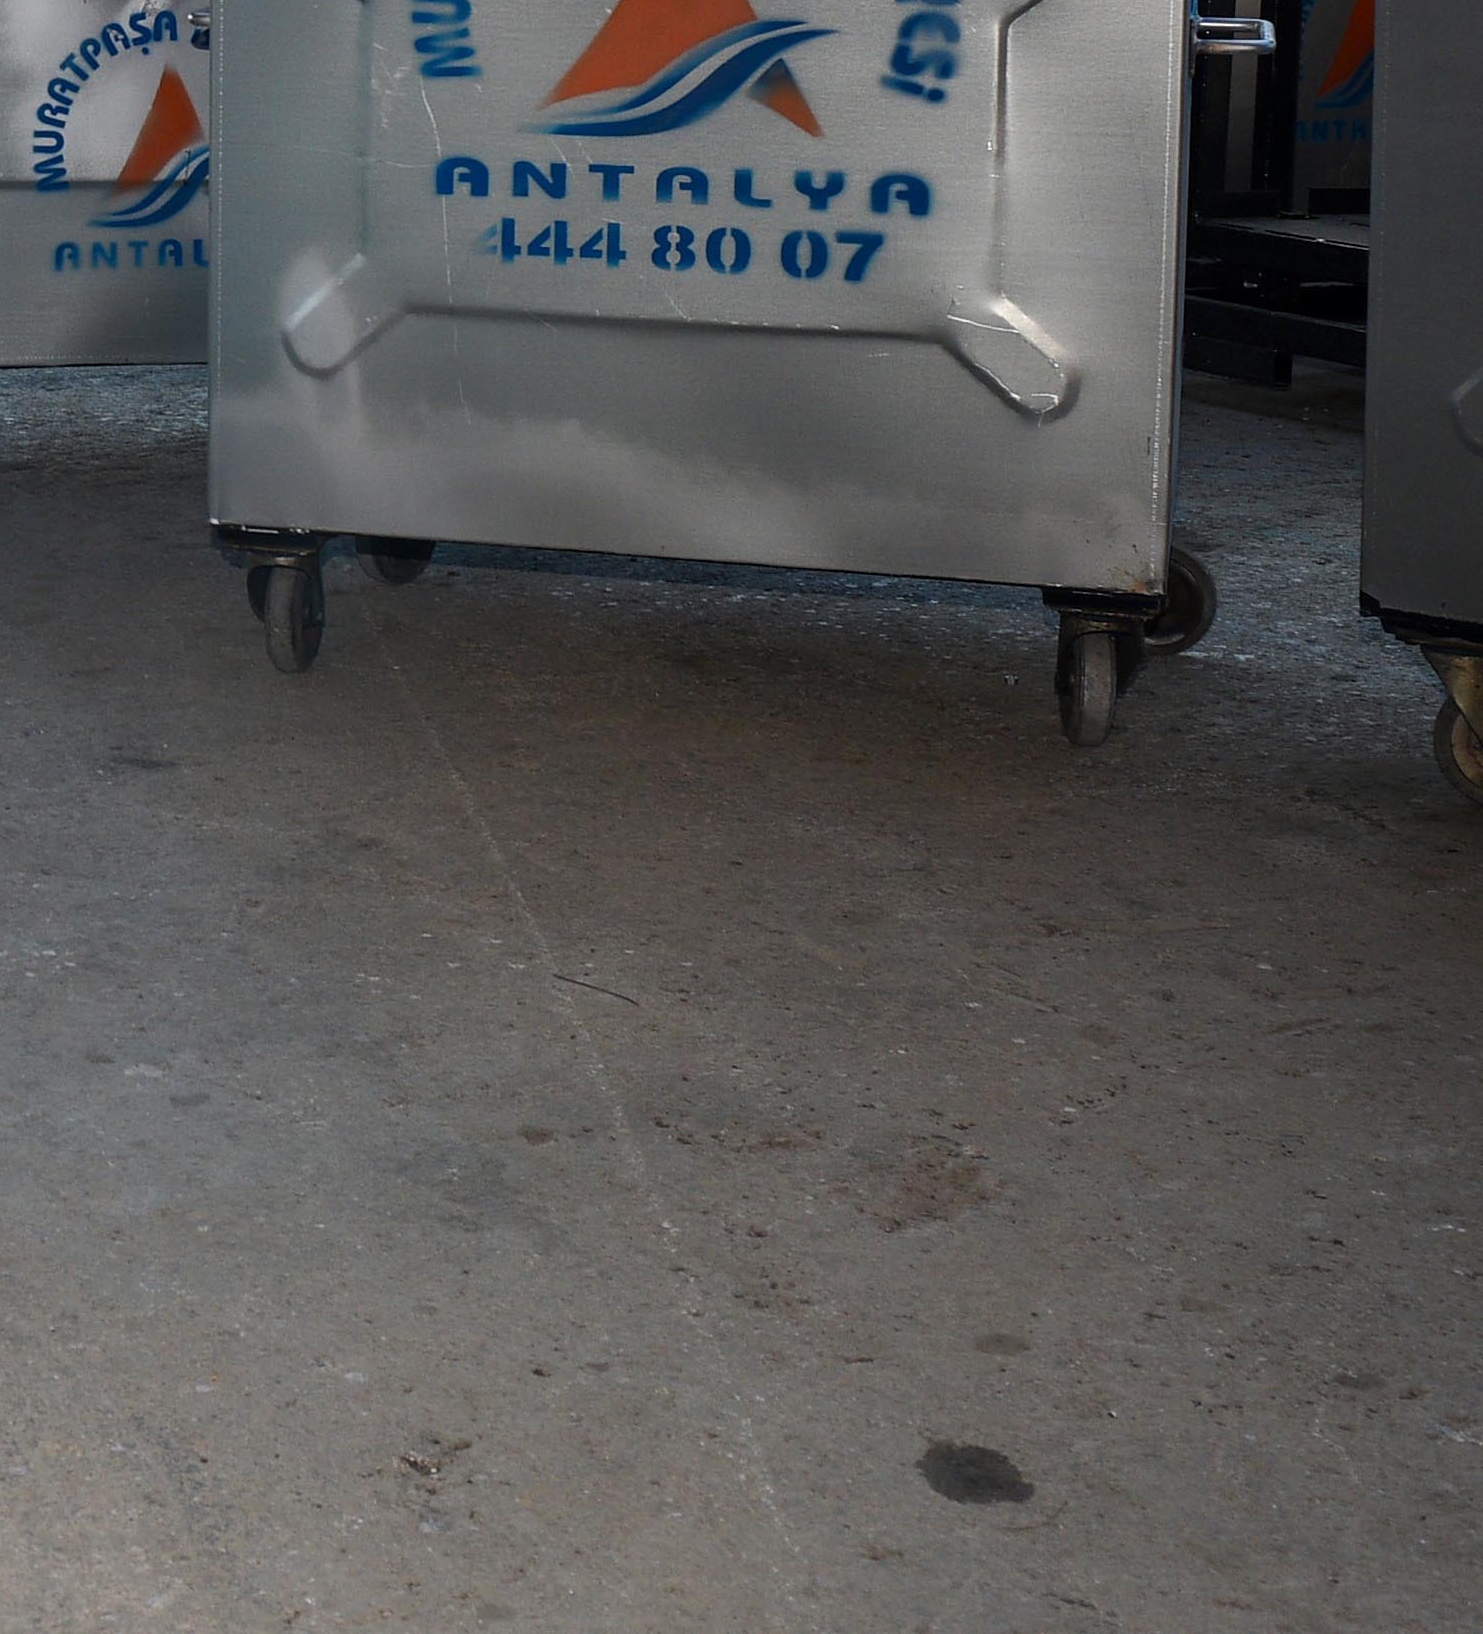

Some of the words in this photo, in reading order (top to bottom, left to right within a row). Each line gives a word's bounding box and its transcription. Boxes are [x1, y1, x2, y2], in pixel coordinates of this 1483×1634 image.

[32, 9, 178, 193] MURATPAŞA
[433, 156, 934, 218] ANTALYA
[53, 239, 210, 272] ANTAL
[475, 216, 628, 266] 444
[650, 224, 753, 276] 80
[779, 229, 885, 284] 07
